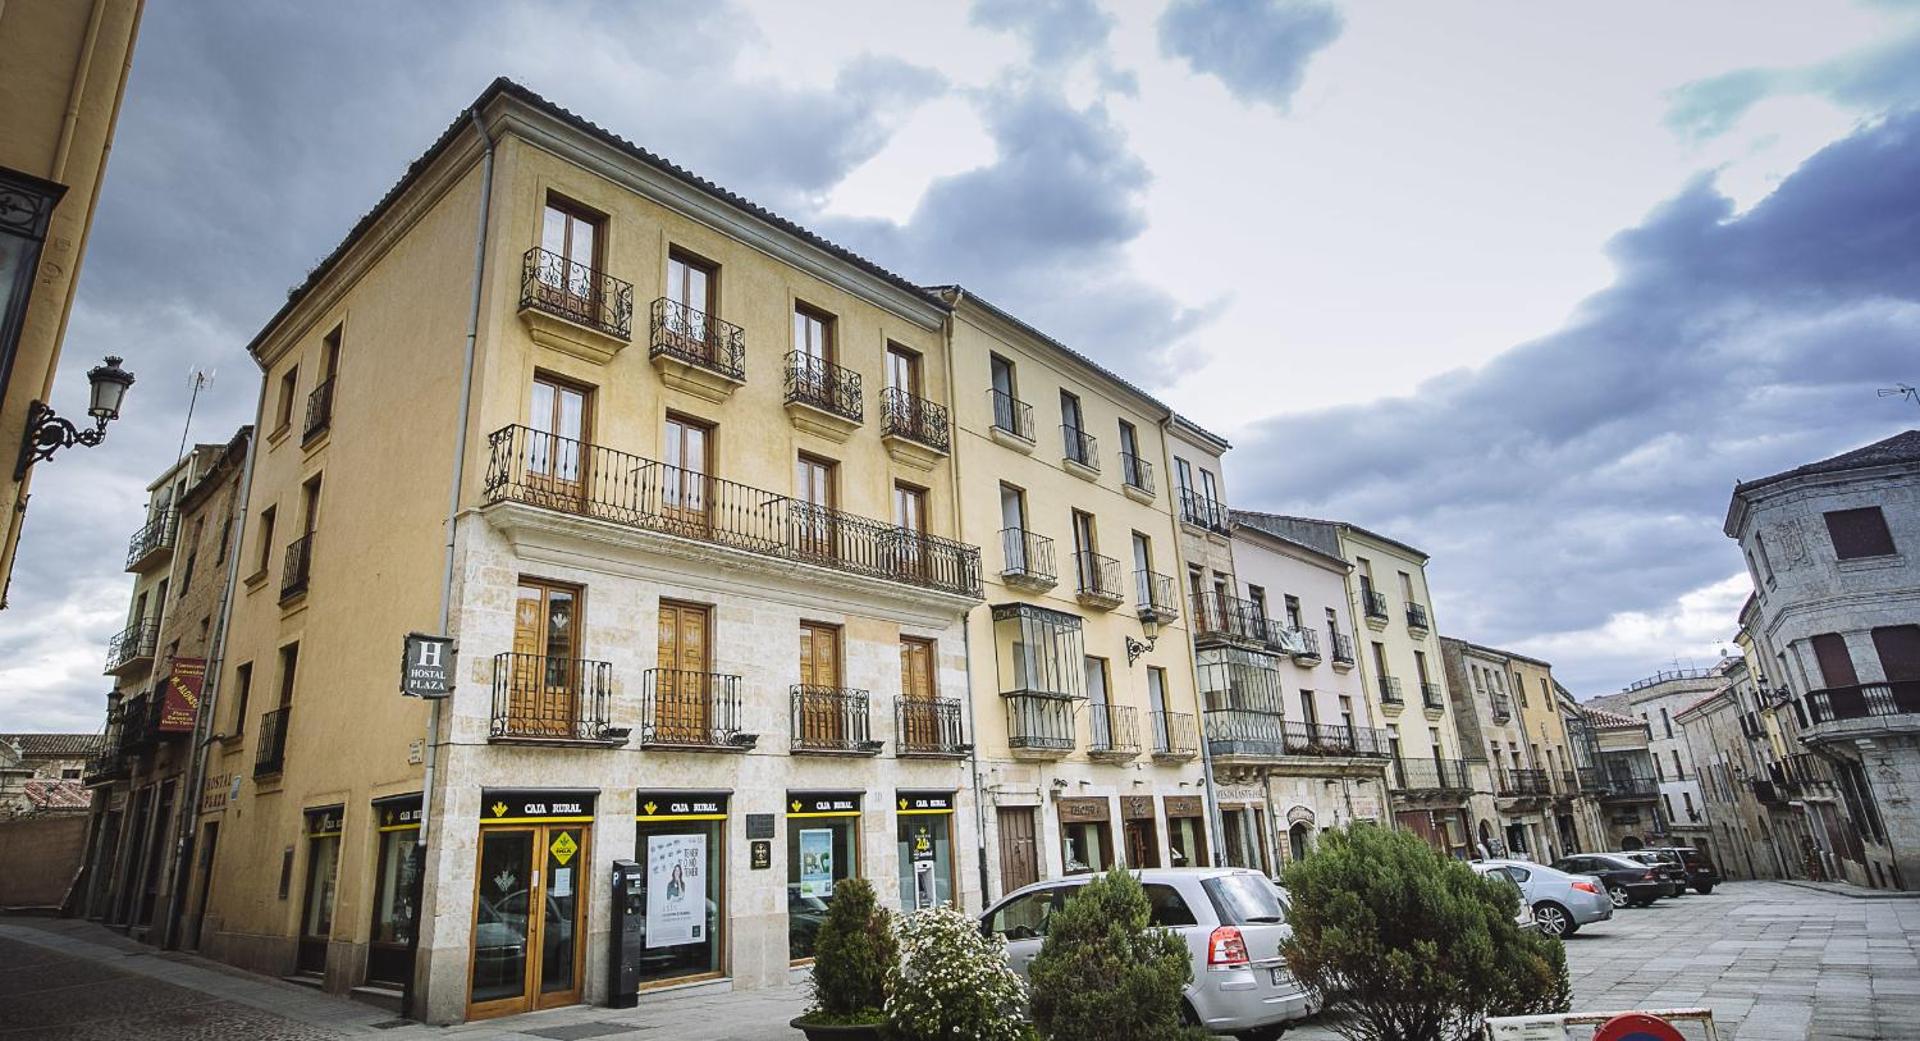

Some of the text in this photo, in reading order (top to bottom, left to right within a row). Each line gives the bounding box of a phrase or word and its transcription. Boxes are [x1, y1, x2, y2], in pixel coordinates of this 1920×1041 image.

[416, 641, 445, 668] H
[410, 669, 446, 680] HOSTAL
[410, 680, 445, 690] PLAZA
[524, 803, 582, 814] CAJA RURAL
[671, 803, 718, 812] CAJA RURAL
[816, 801, 853, 810] CAJA RURAL
[915, 799, 947, 808] CAJA RURAL
